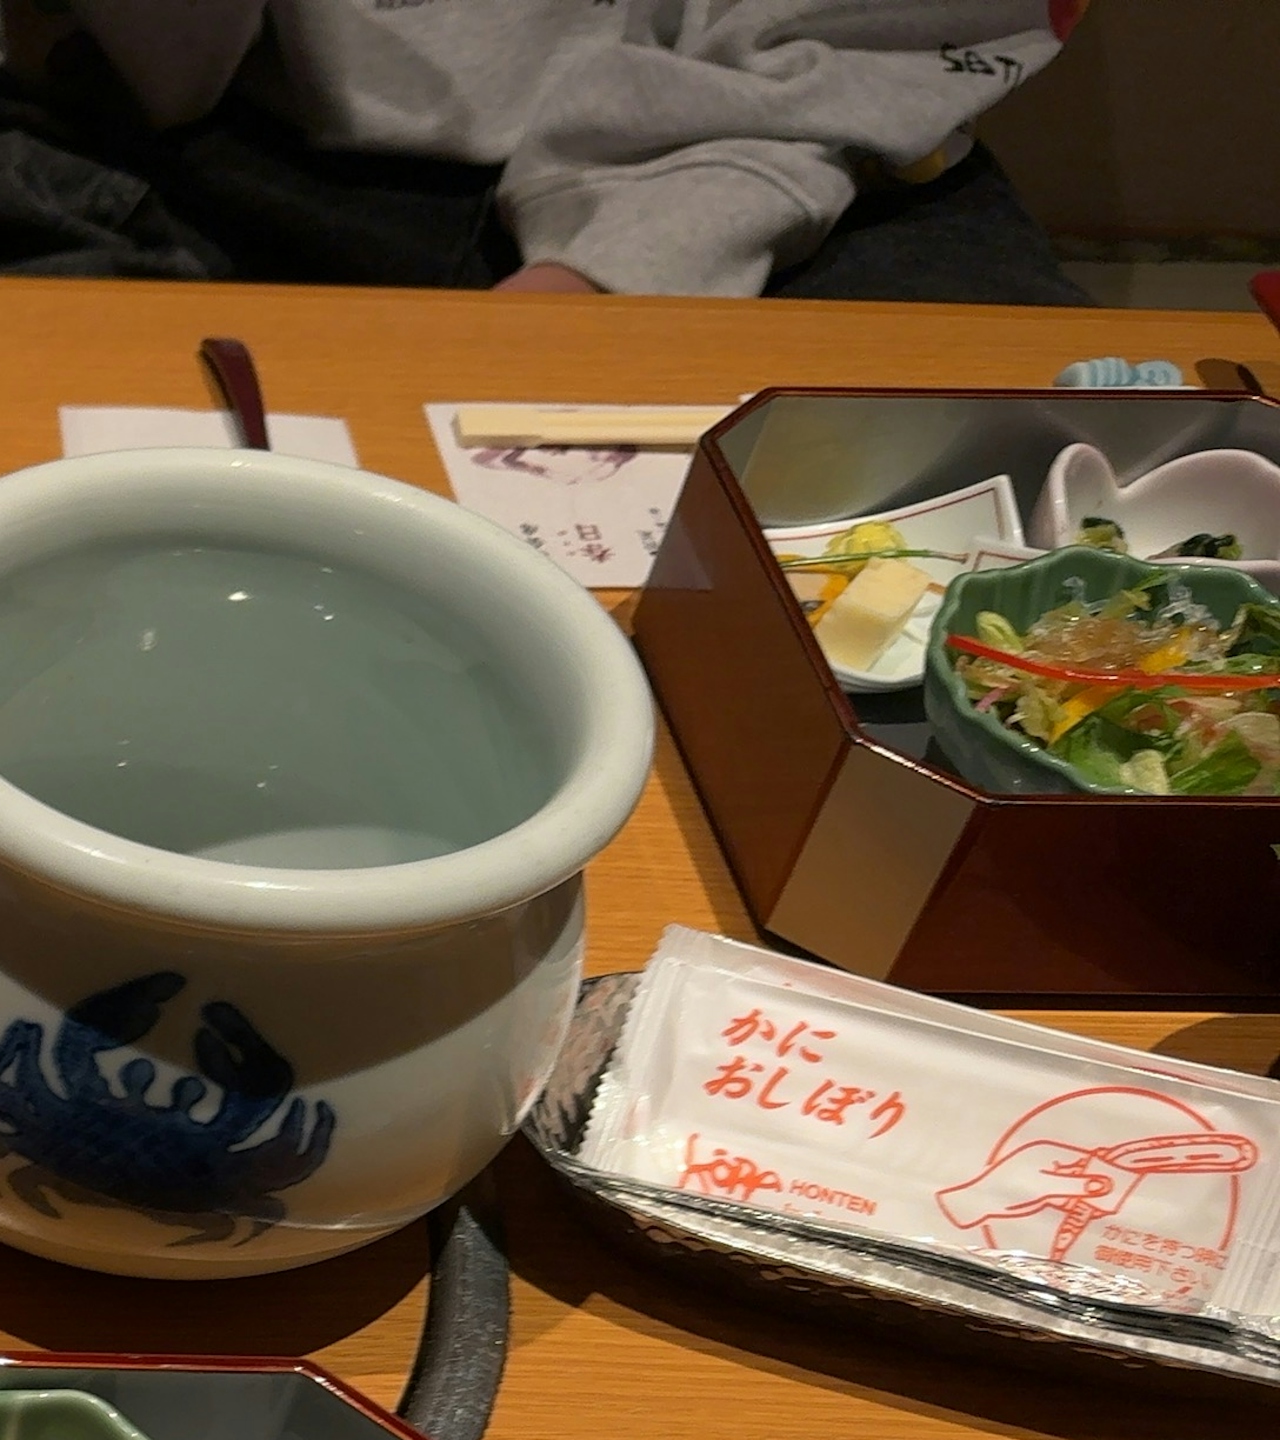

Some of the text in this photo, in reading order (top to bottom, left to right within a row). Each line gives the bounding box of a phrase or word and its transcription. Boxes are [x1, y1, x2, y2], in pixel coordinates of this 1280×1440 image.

[720, 1007, 838, 1066] かに
[702, 1055, 909, 1139] おしぼり
[789, 1179, 877, 1216] HONTEN
